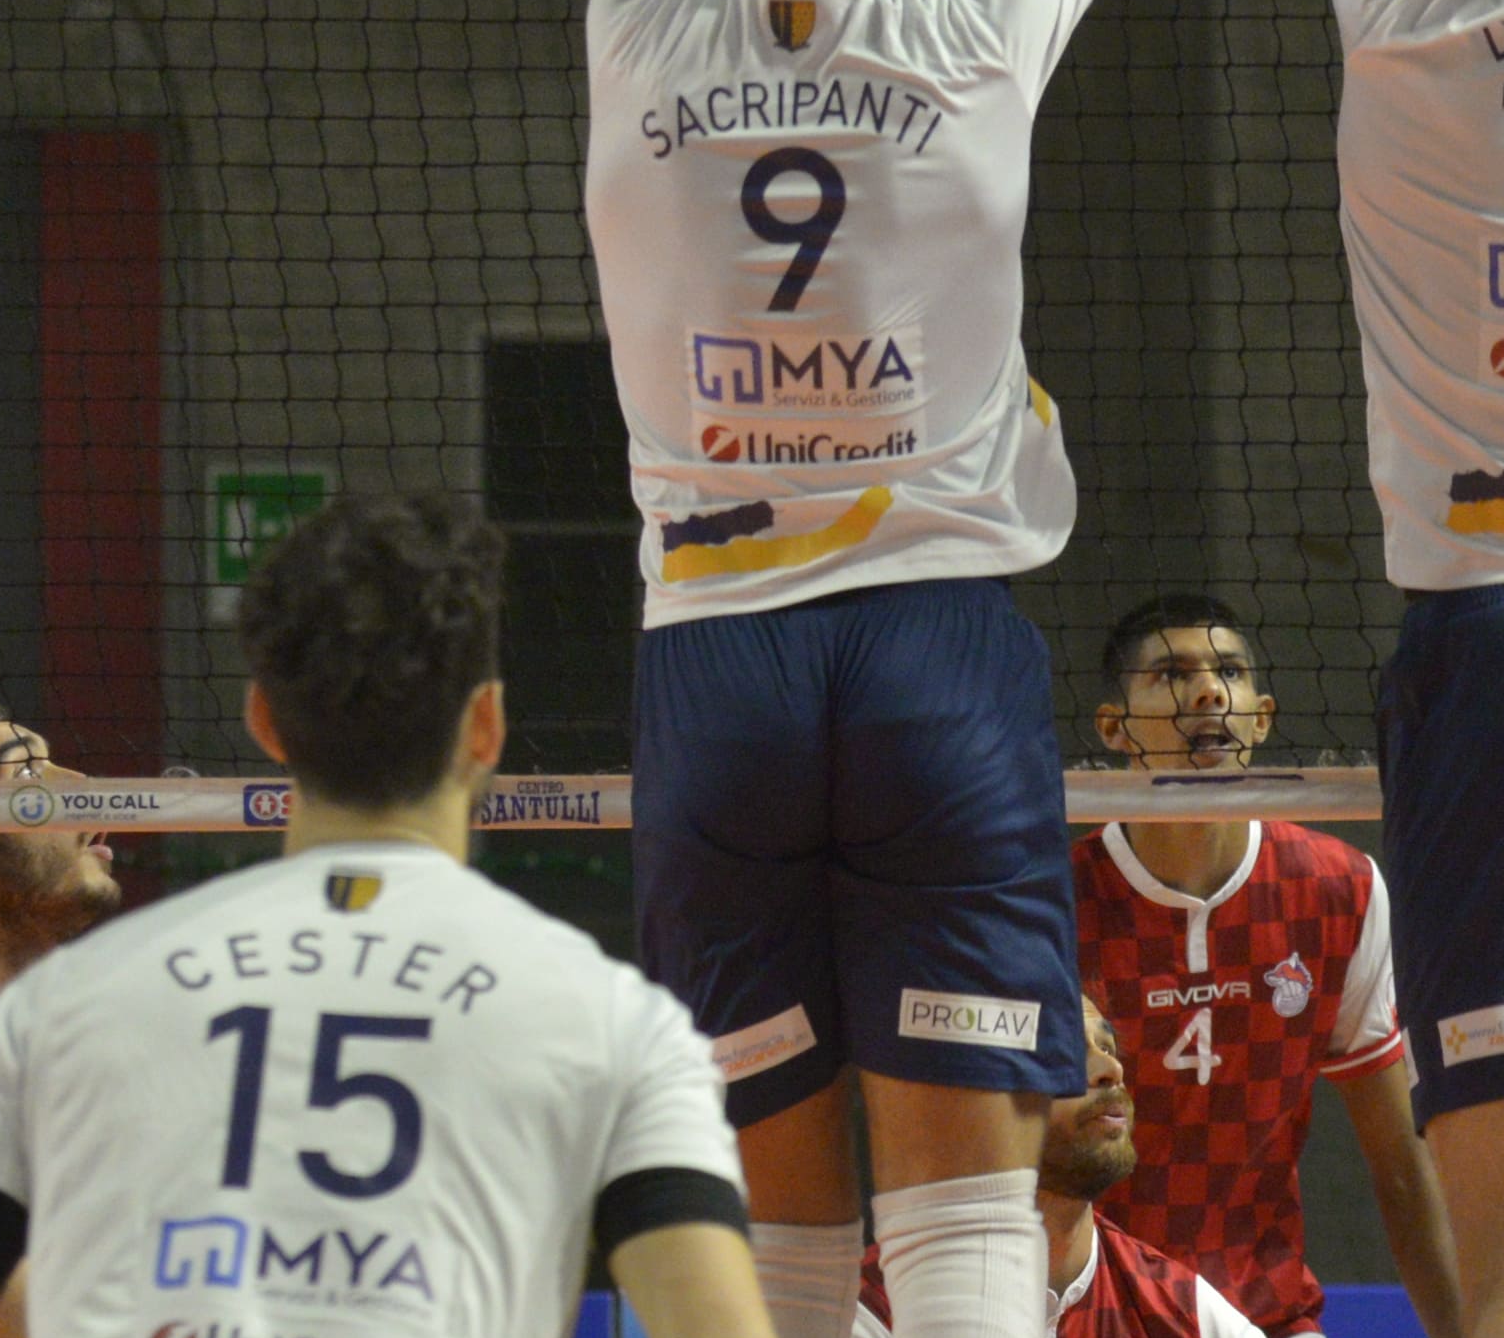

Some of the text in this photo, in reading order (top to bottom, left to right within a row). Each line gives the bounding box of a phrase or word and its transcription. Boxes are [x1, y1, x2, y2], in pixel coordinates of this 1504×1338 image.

[642, 80, 943, 160] SACRIPANTI
[740, 146, 847, 313] 9
[773, 336, 914, 390] MYA
[773, 386, 916, 408] Servizi & Gestione
[746, 430, 917, 465] UniCredit
[61, 795, 160, 810] YOU CALL
[480, 791, 599, 824] SANTULLI
[517, 781, 564, 793] CENTRO
[166, 930, 497, 1013] CESTER
[1148, 981, 1251, 1008] GIVOVA
[912, 1002, 1030, 1039] PROLAV
[1162, 1007, 1222, 1086] 4
[205, 1004, 432, 1199] 15
[257, 1227, 434, 1302] MYA
